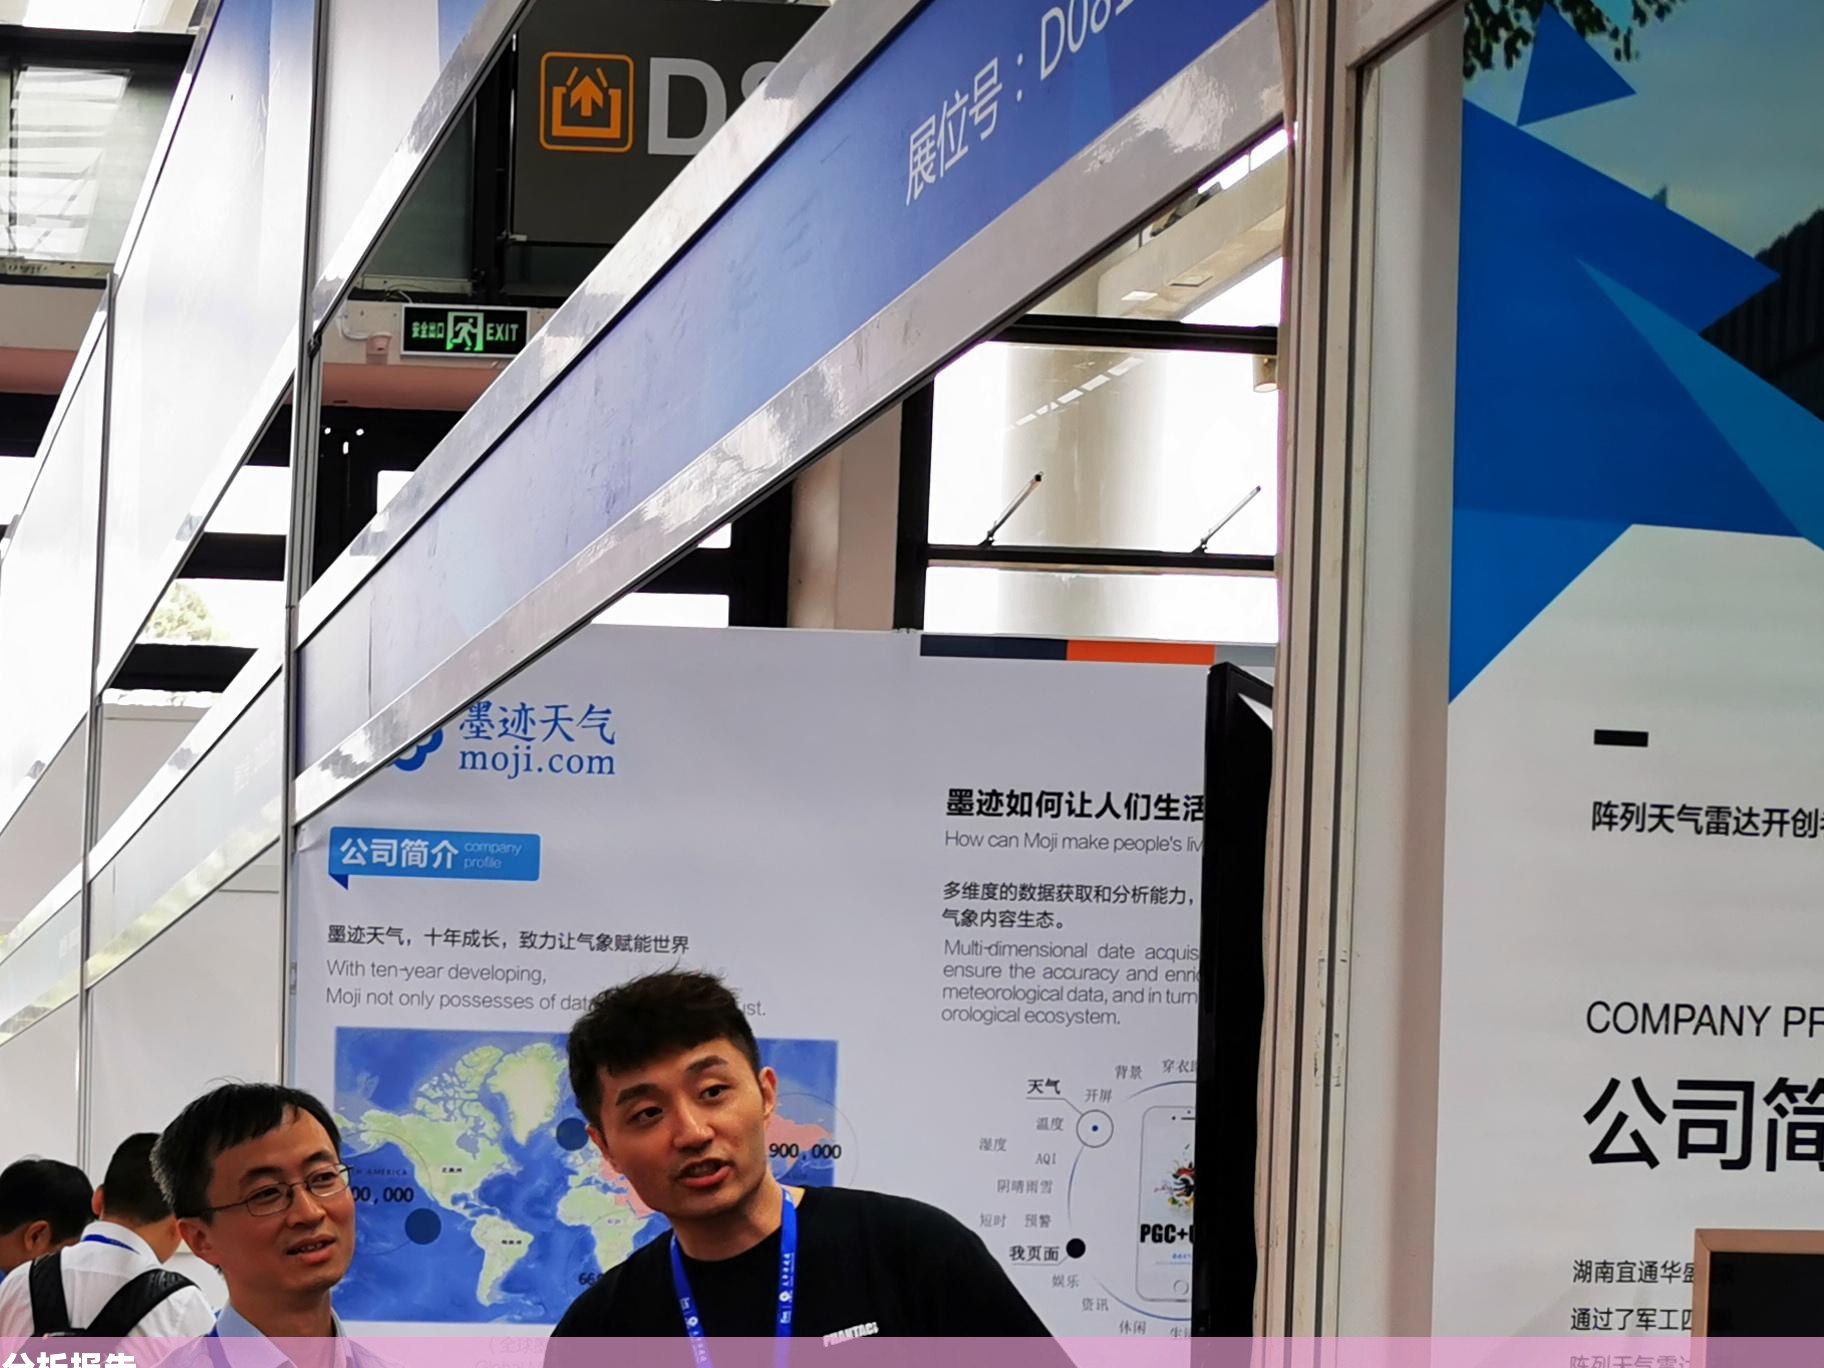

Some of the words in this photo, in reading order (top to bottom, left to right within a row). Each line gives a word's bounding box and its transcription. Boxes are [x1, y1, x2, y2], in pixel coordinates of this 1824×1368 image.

[647, 57, 780, 156] D
[486, 322, 519, 341] EXIT
[459, 701, 616, 746] 墨迹天气
[459, 746, 616, 779] moji.com
[946, 788, 1205, 822] 墨迹如何让人们生活
[1591, 800, 1824, 840] 阵列天气雷达开创
[339, 837, 459, 870] 公司简介
[464, 841, 522, 857] company
[945, 831, 984, 848] How
[988, 835, 1019, 848] can
[1024, 832, 1058, 852] Moji
[1062, 834, 1109, 851] make
[1113, 835, 1182, 855] people's
[464, 856, 502, 870] profile
[942, 908, 1064, 930] 气象内容生态。
[944, 939, 1088, 959] Multi-dimensional
[1097, 943, 1135, 960] date
[326, 959, 365, 978] With
[370, 961, 444, 984] ten-year
[448, 964, 547, 987] developing,
[943, 964, 1002, 979] ensure
[1009, 963, 1036, 980] the
[1042, 966, 1119, 985] accuracy
[1126, 965, 1158, 982] and
[326, 988, 362, 1010] Moji
[365, 990, 394, 1007] not
[398, 991, 435, 1012] only
[439, 994, 535, 1013] possesses
[539, 992, 557, 1010] of
[942, 984, 1063, 1006] meteorological
[1066, 986, 1108, 1006] data,
[1112, 987, 1145, 1004] and
[1148, 987, 1161, 1004] in
[941, 1006, 1020, 1026] orological
[1024, 1008, 1121, 1027] ecosystem.
[1586, 1001, 1771, 1037] COMPANY
[1027, 1078, 1061, 1095] 天气
[1583, 1076, 1824, 1173] 公司简
[1035, 1152, 1057, 1166] AQI
[1009, 1245, 1060, 1262] 我页面
